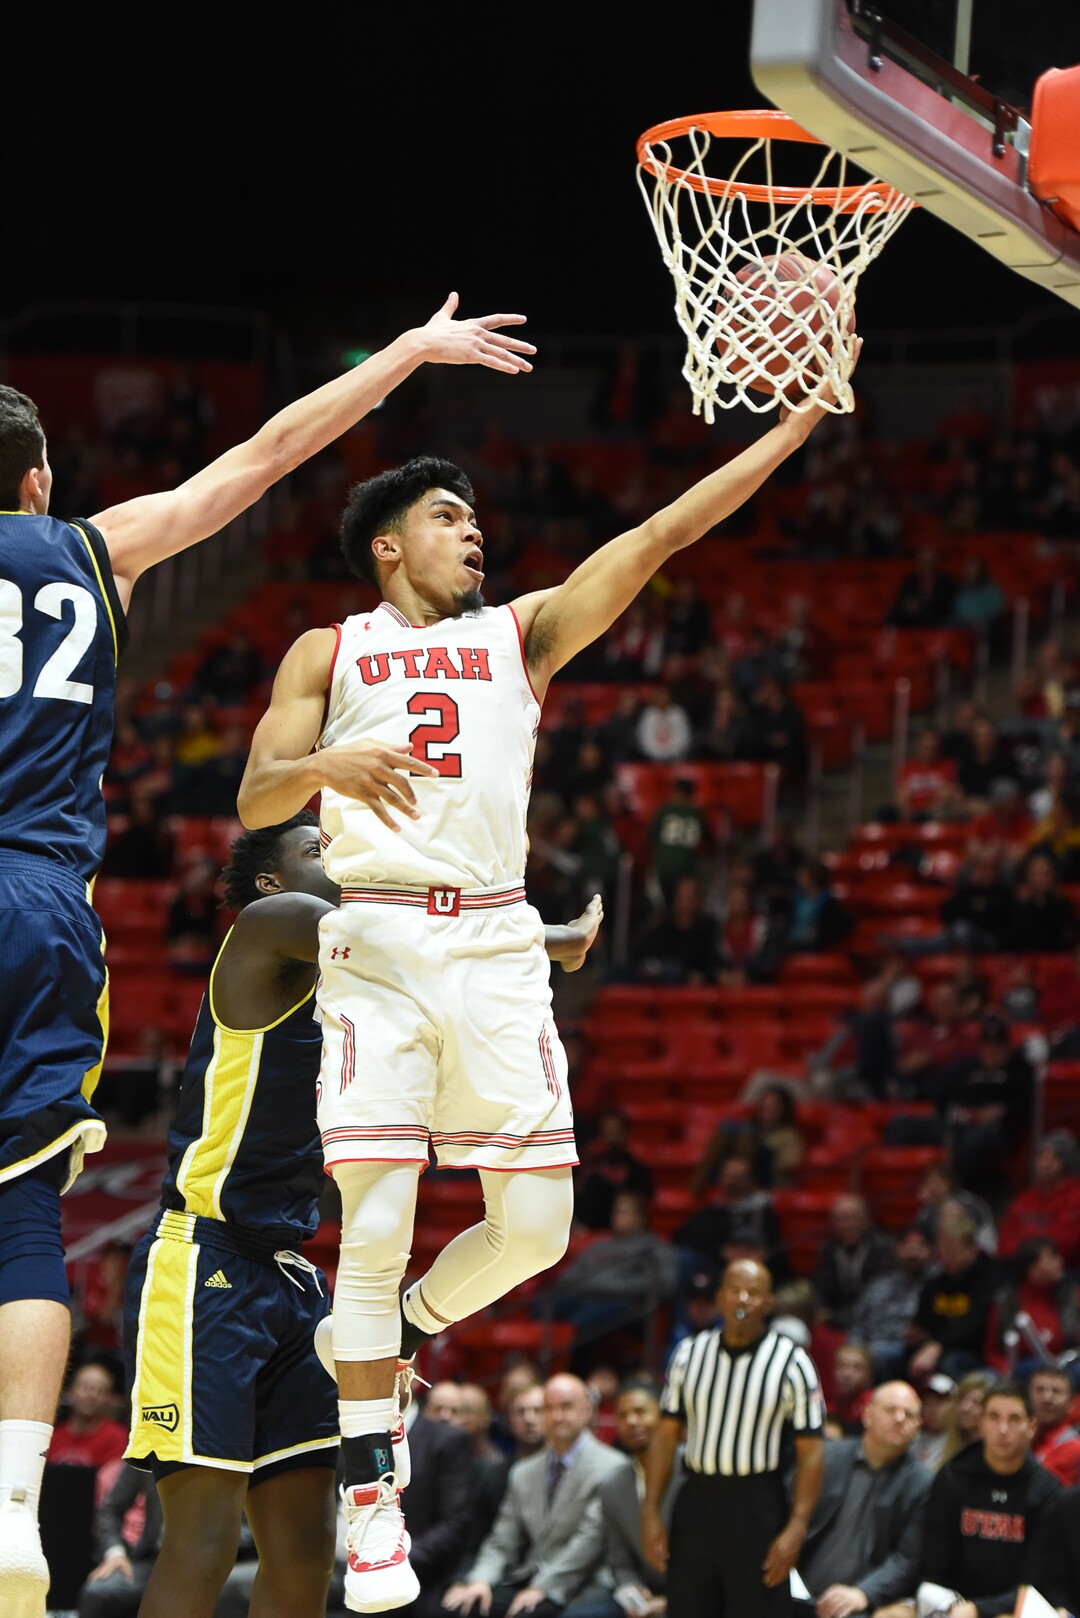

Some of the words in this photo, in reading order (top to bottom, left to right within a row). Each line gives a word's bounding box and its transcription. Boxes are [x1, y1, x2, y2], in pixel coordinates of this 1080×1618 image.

[356, 647, 492, 686] UTAH
[406, 691, 462, 778] 2
[433, 890, 456, 913] U
[204, 1280, 233, 1289] adidas
[141, 1411, 173, 1422] NAU
